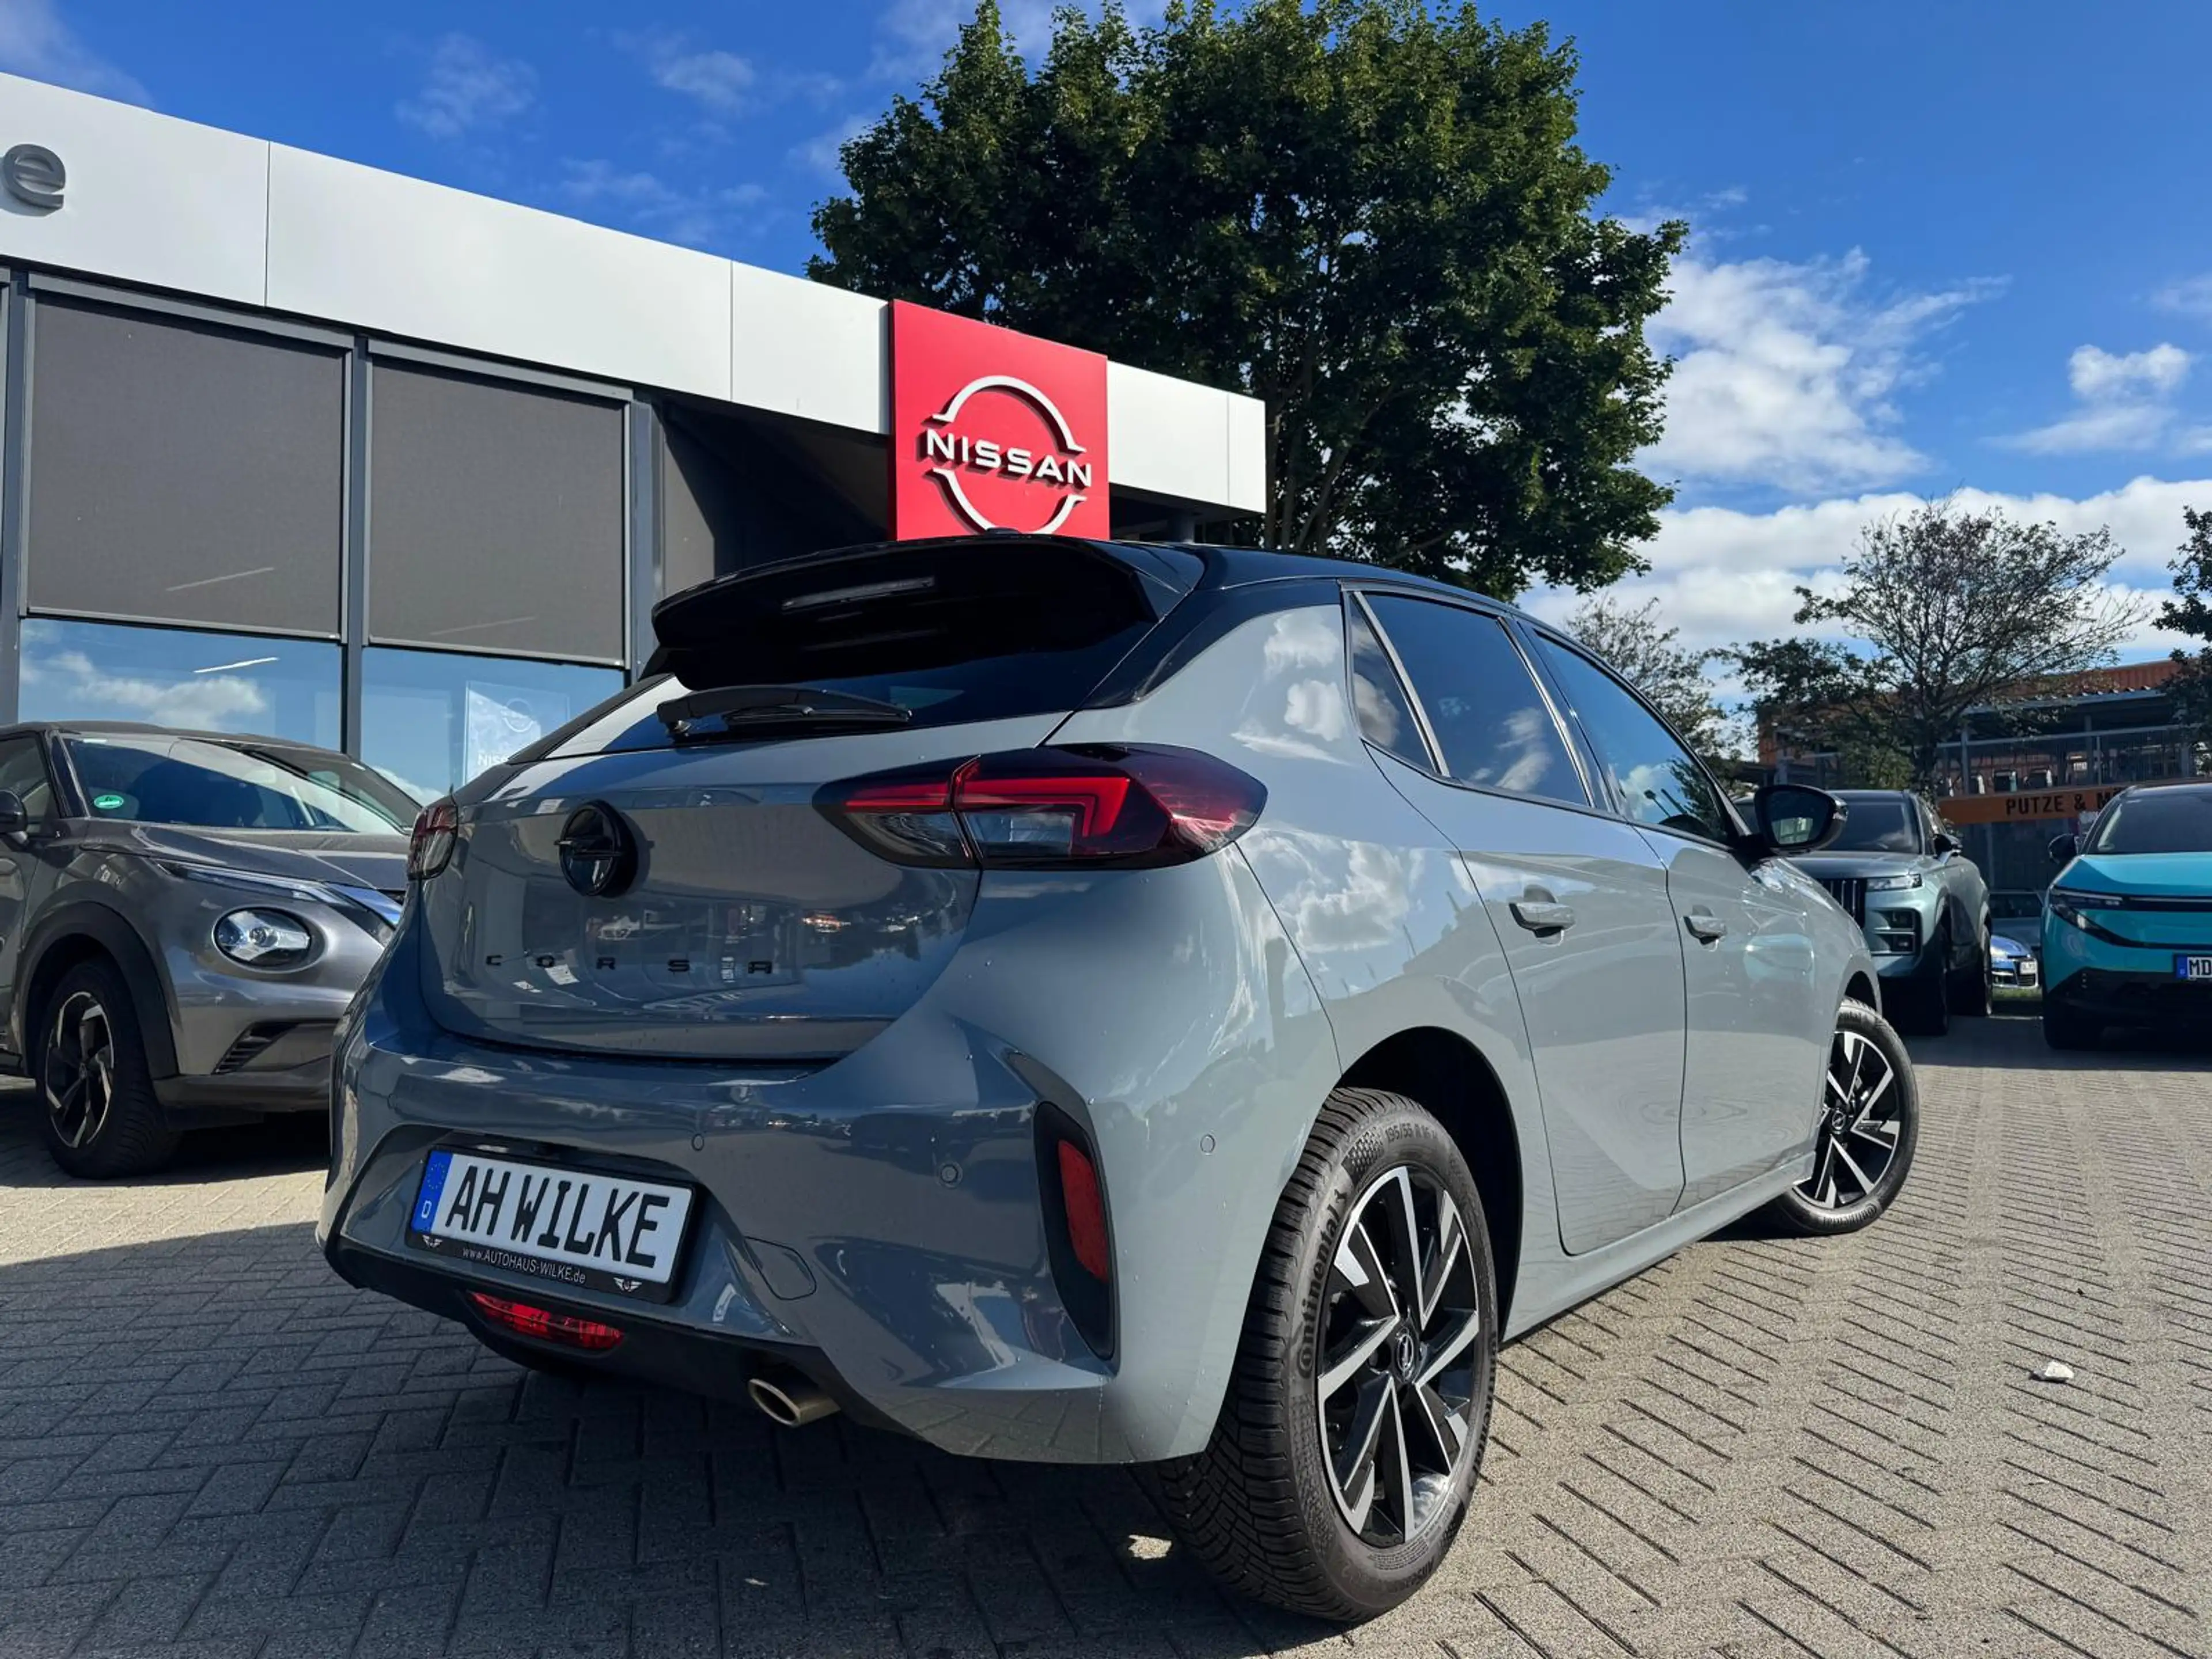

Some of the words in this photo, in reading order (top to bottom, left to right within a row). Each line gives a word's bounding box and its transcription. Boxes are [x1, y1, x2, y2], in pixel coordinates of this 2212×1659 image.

[924, 428, 1092, 488] NISSAN
[2005, 795, 2065, 816] PUTZE
[2074, 793, 2086, 811] &
[486, 953, 773, 975] CORSA
[2188, 959, 2212, 976] MD
[444, 1165, 512, 1236] AH
[510, 1174, 670, 1268] WILKE
[462, 1247, 586, 1285] www.AUTOHAUS-WILKE.de
[1297, 1204, 1340, 1378] Continental
